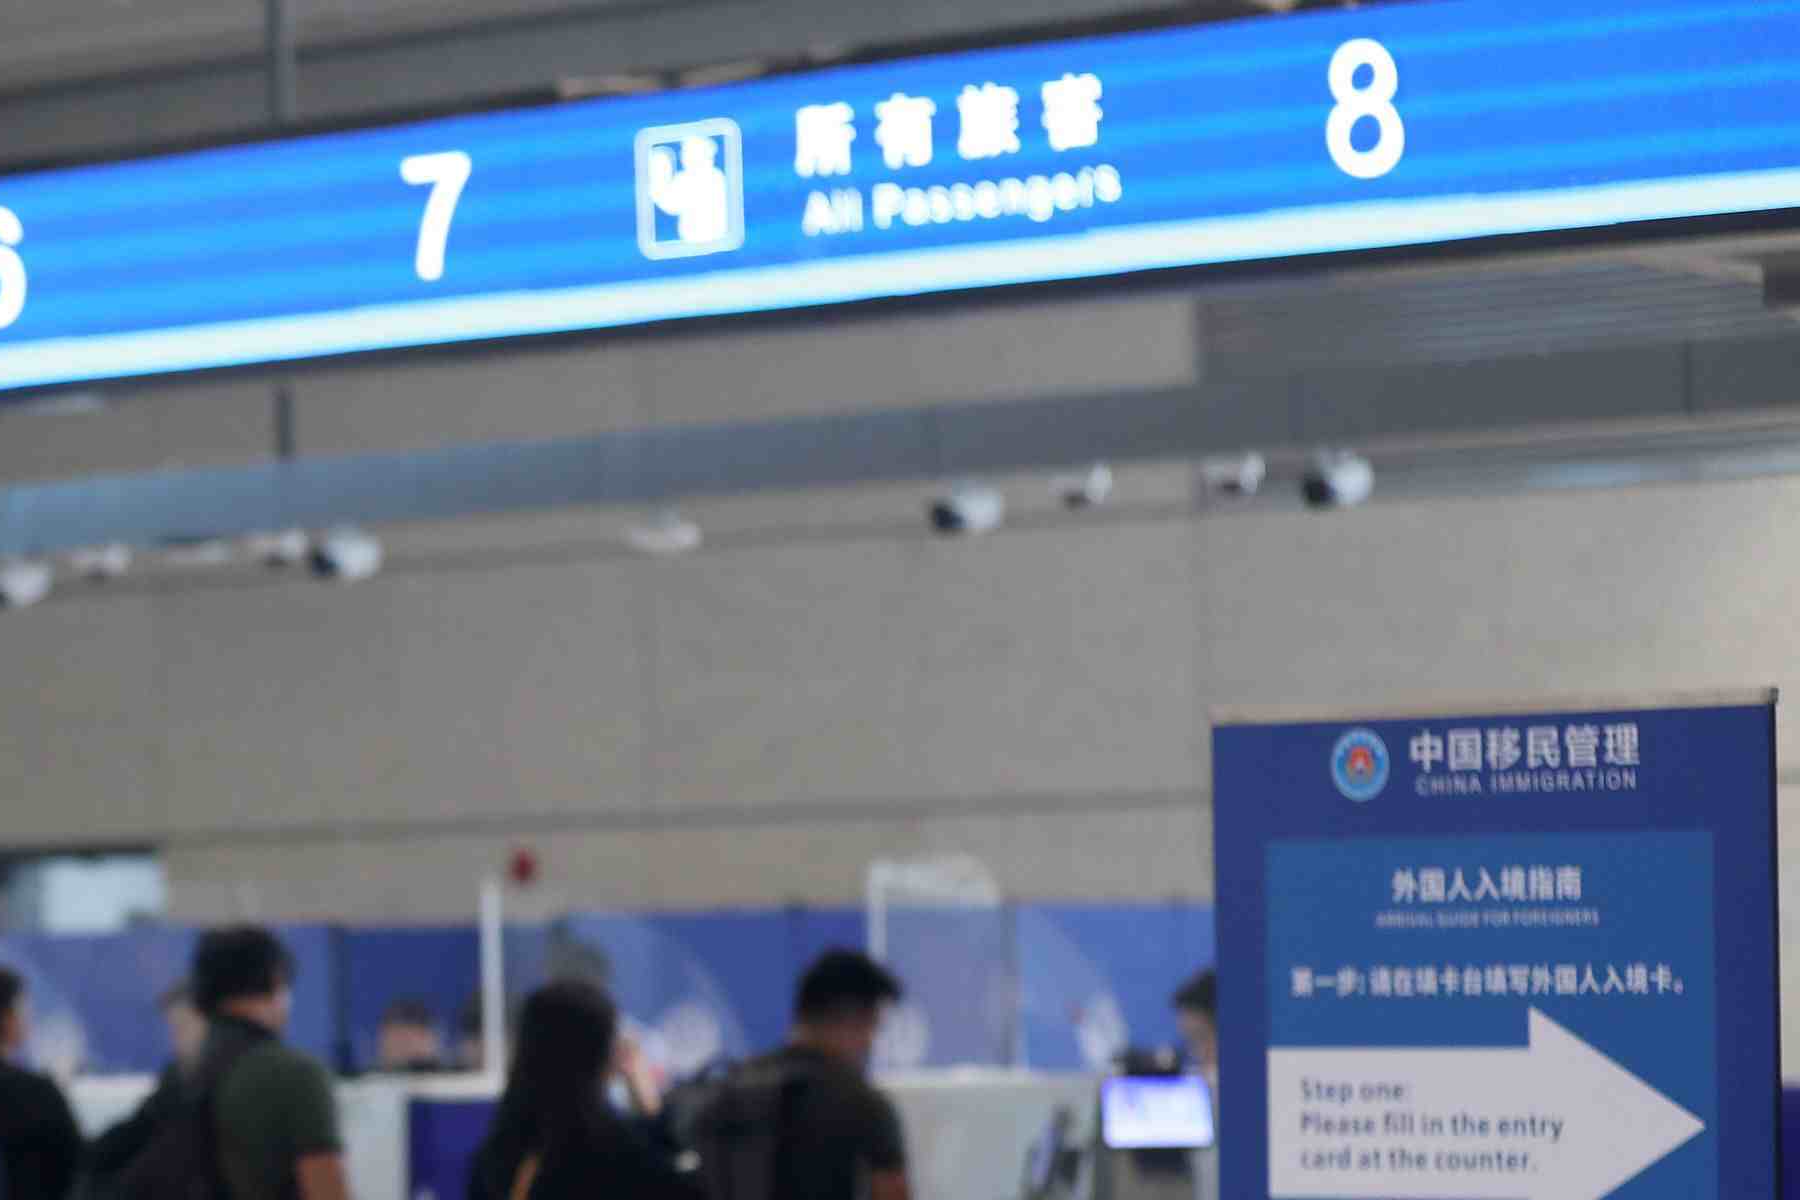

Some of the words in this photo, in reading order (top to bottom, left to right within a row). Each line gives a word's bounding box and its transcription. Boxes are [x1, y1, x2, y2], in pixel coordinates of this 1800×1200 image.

[1324, 37, 1405, 178] 8
[400, 151, 472, 281] 7
[802, 187, 864, 237] All
[872, 164, 1122, 231] Passengers
[1409, 723, 1641, 774] 中国移民管理
[1414, 773, 1483, 797] CHINA
[1489, 767, 1638, 793] IMMIGRATION
[1391, 863, 1582, 904] 外国人入境指南
[1300, 1077, 1354, 1106] Step
[1301, 1112, 1375, 1136] Please
[1383, 1110, 1415, 1135] fill
[1421, 1112, 1444, 1136] in
[1450, 1112, 1491, 1137] the
[1497, 1113, 1564, 1142] entry
[1301, 1147, 1352, 1171] card
[1358, 1149, 1382, 1171] at
[1388, 1147, 1428, 1172] the
[1433, 1150, 1538, 1173] counter.
